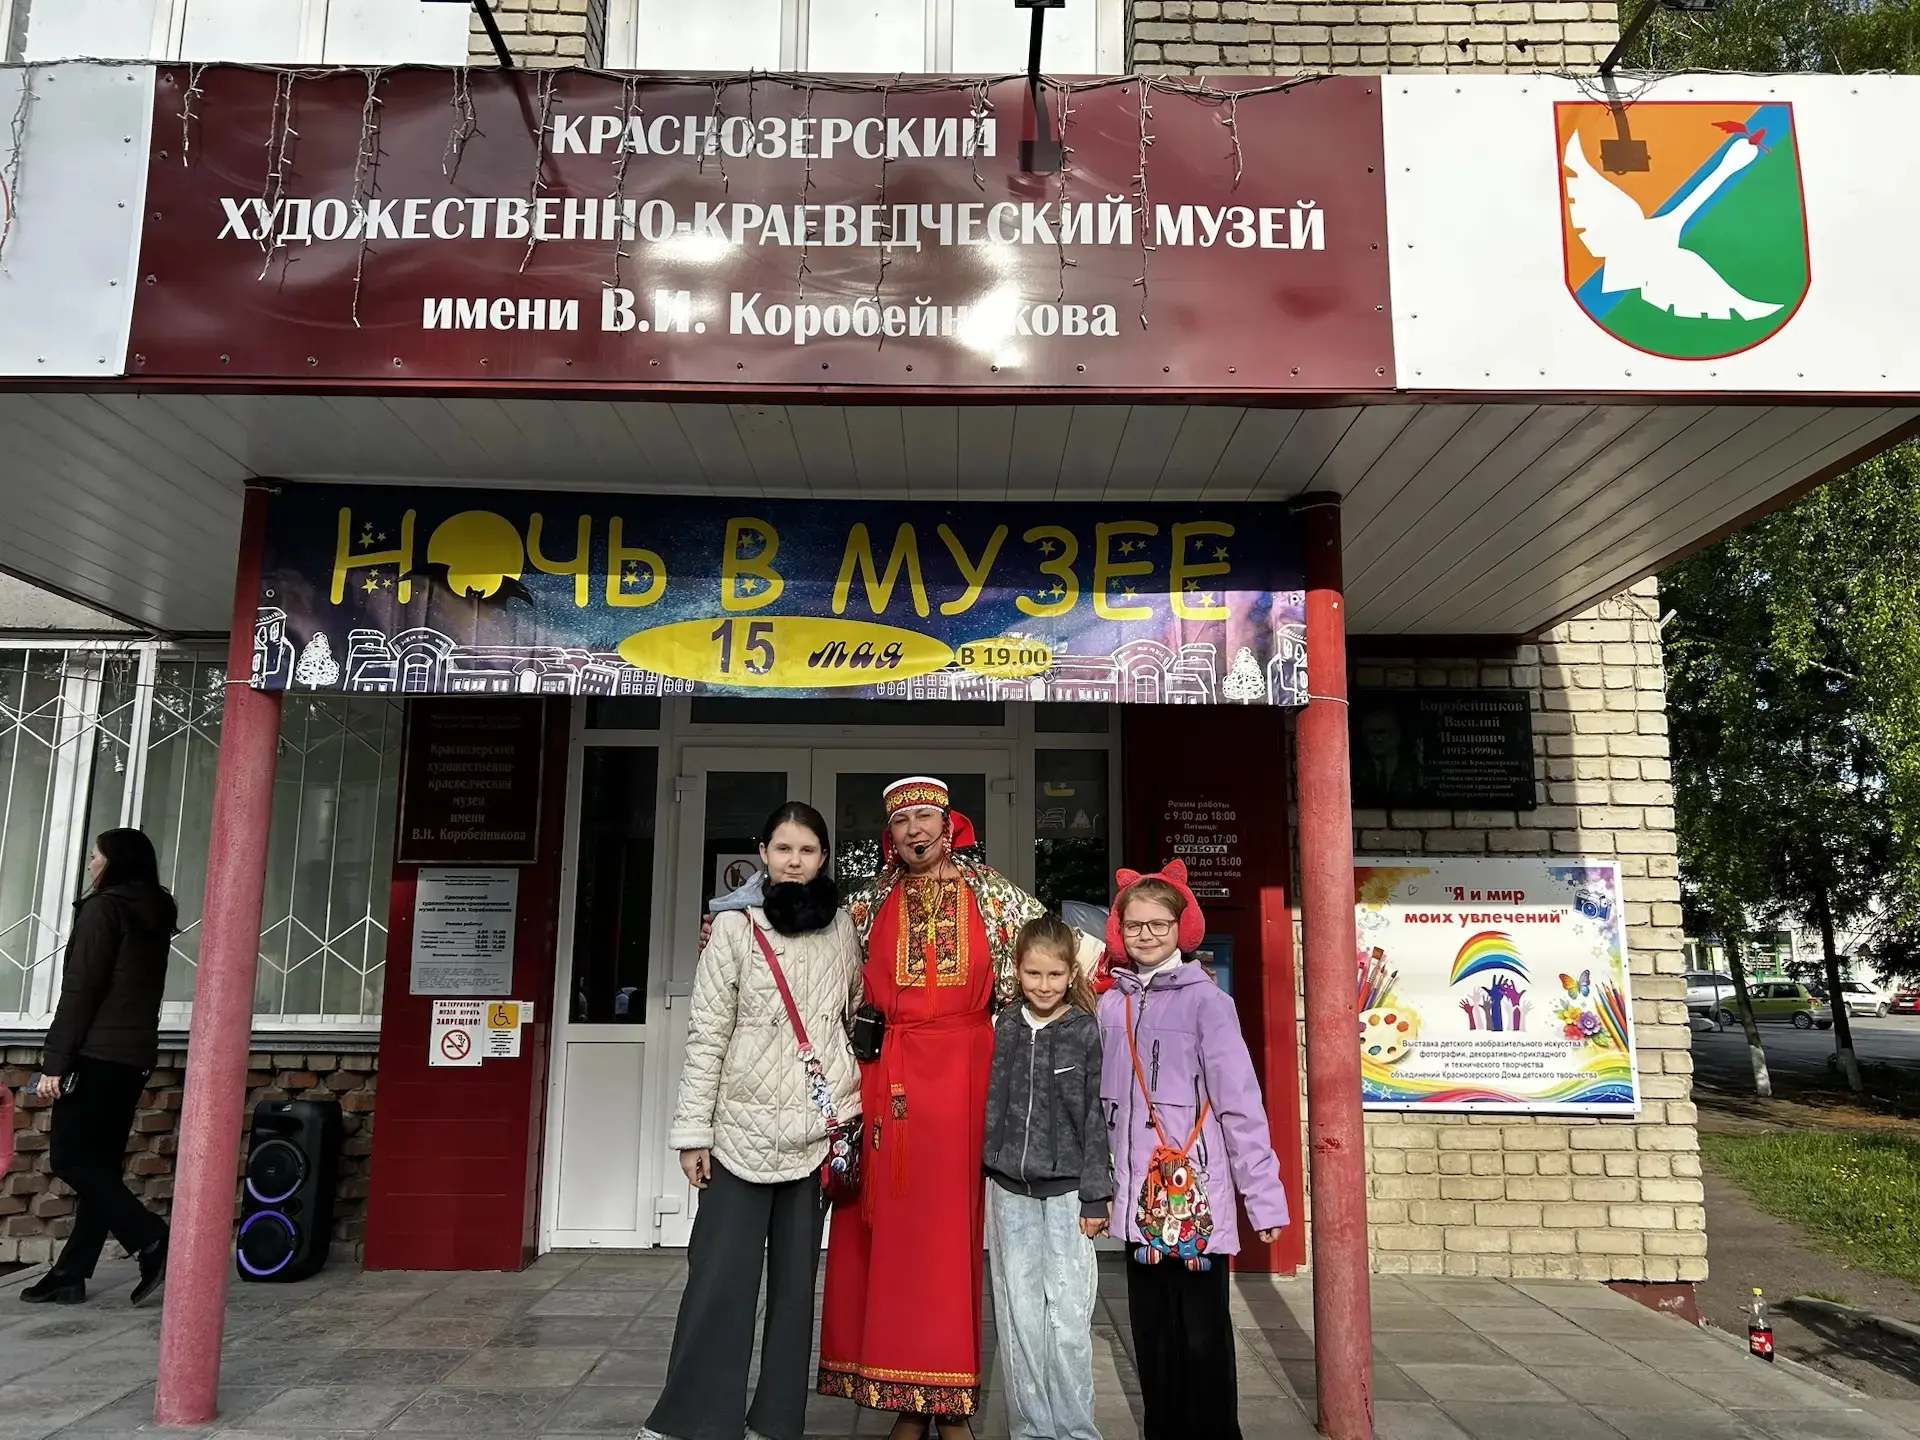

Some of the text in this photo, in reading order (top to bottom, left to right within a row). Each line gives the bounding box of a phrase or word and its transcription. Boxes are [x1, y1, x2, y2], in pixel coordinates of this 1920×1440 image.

[552, 110, 997, 159] КРАСНОЗЕРСКИЙ
[217, 193, 1326, 253] ХУДОЖЕСТВЕННО-КРАЕВЕДЧЕСКИЙ МУЗЕЙ
[422, 288, 1120, 345] имени В.И. Коробейнкова
[330, 507, 1236, 621] НОЧЬ В МУЗЕЕ
[711, 619, 775, 676] 15
[808, 640, 904, 669] мая
[983, 647, 1047, 667] 19.00
[1168, 800, 1230, 809] Режим работы
[1173, 811, 1193, 820] 9:00
[1196, 813, 1209, 821] до
[1211, 811, 1236, 820] 18:00
[1174, 834, 1194, 843] 9:00
[1197, 836, 1210, 844] до
[1212, 834, 1238, 843] 17:00
[1199, 858, 1213, 867] до
[1216, 857, 1242, 866] 15:00
[1470, 890, 1481, 901] и
[1487, 890, 1525, 905] мир
[1404, 909, 1568, 928] моих увлечений"
[1442, 1071, 1500, 1080] Краснозерского
[1501, 1071, 1521, 1080] Дома
